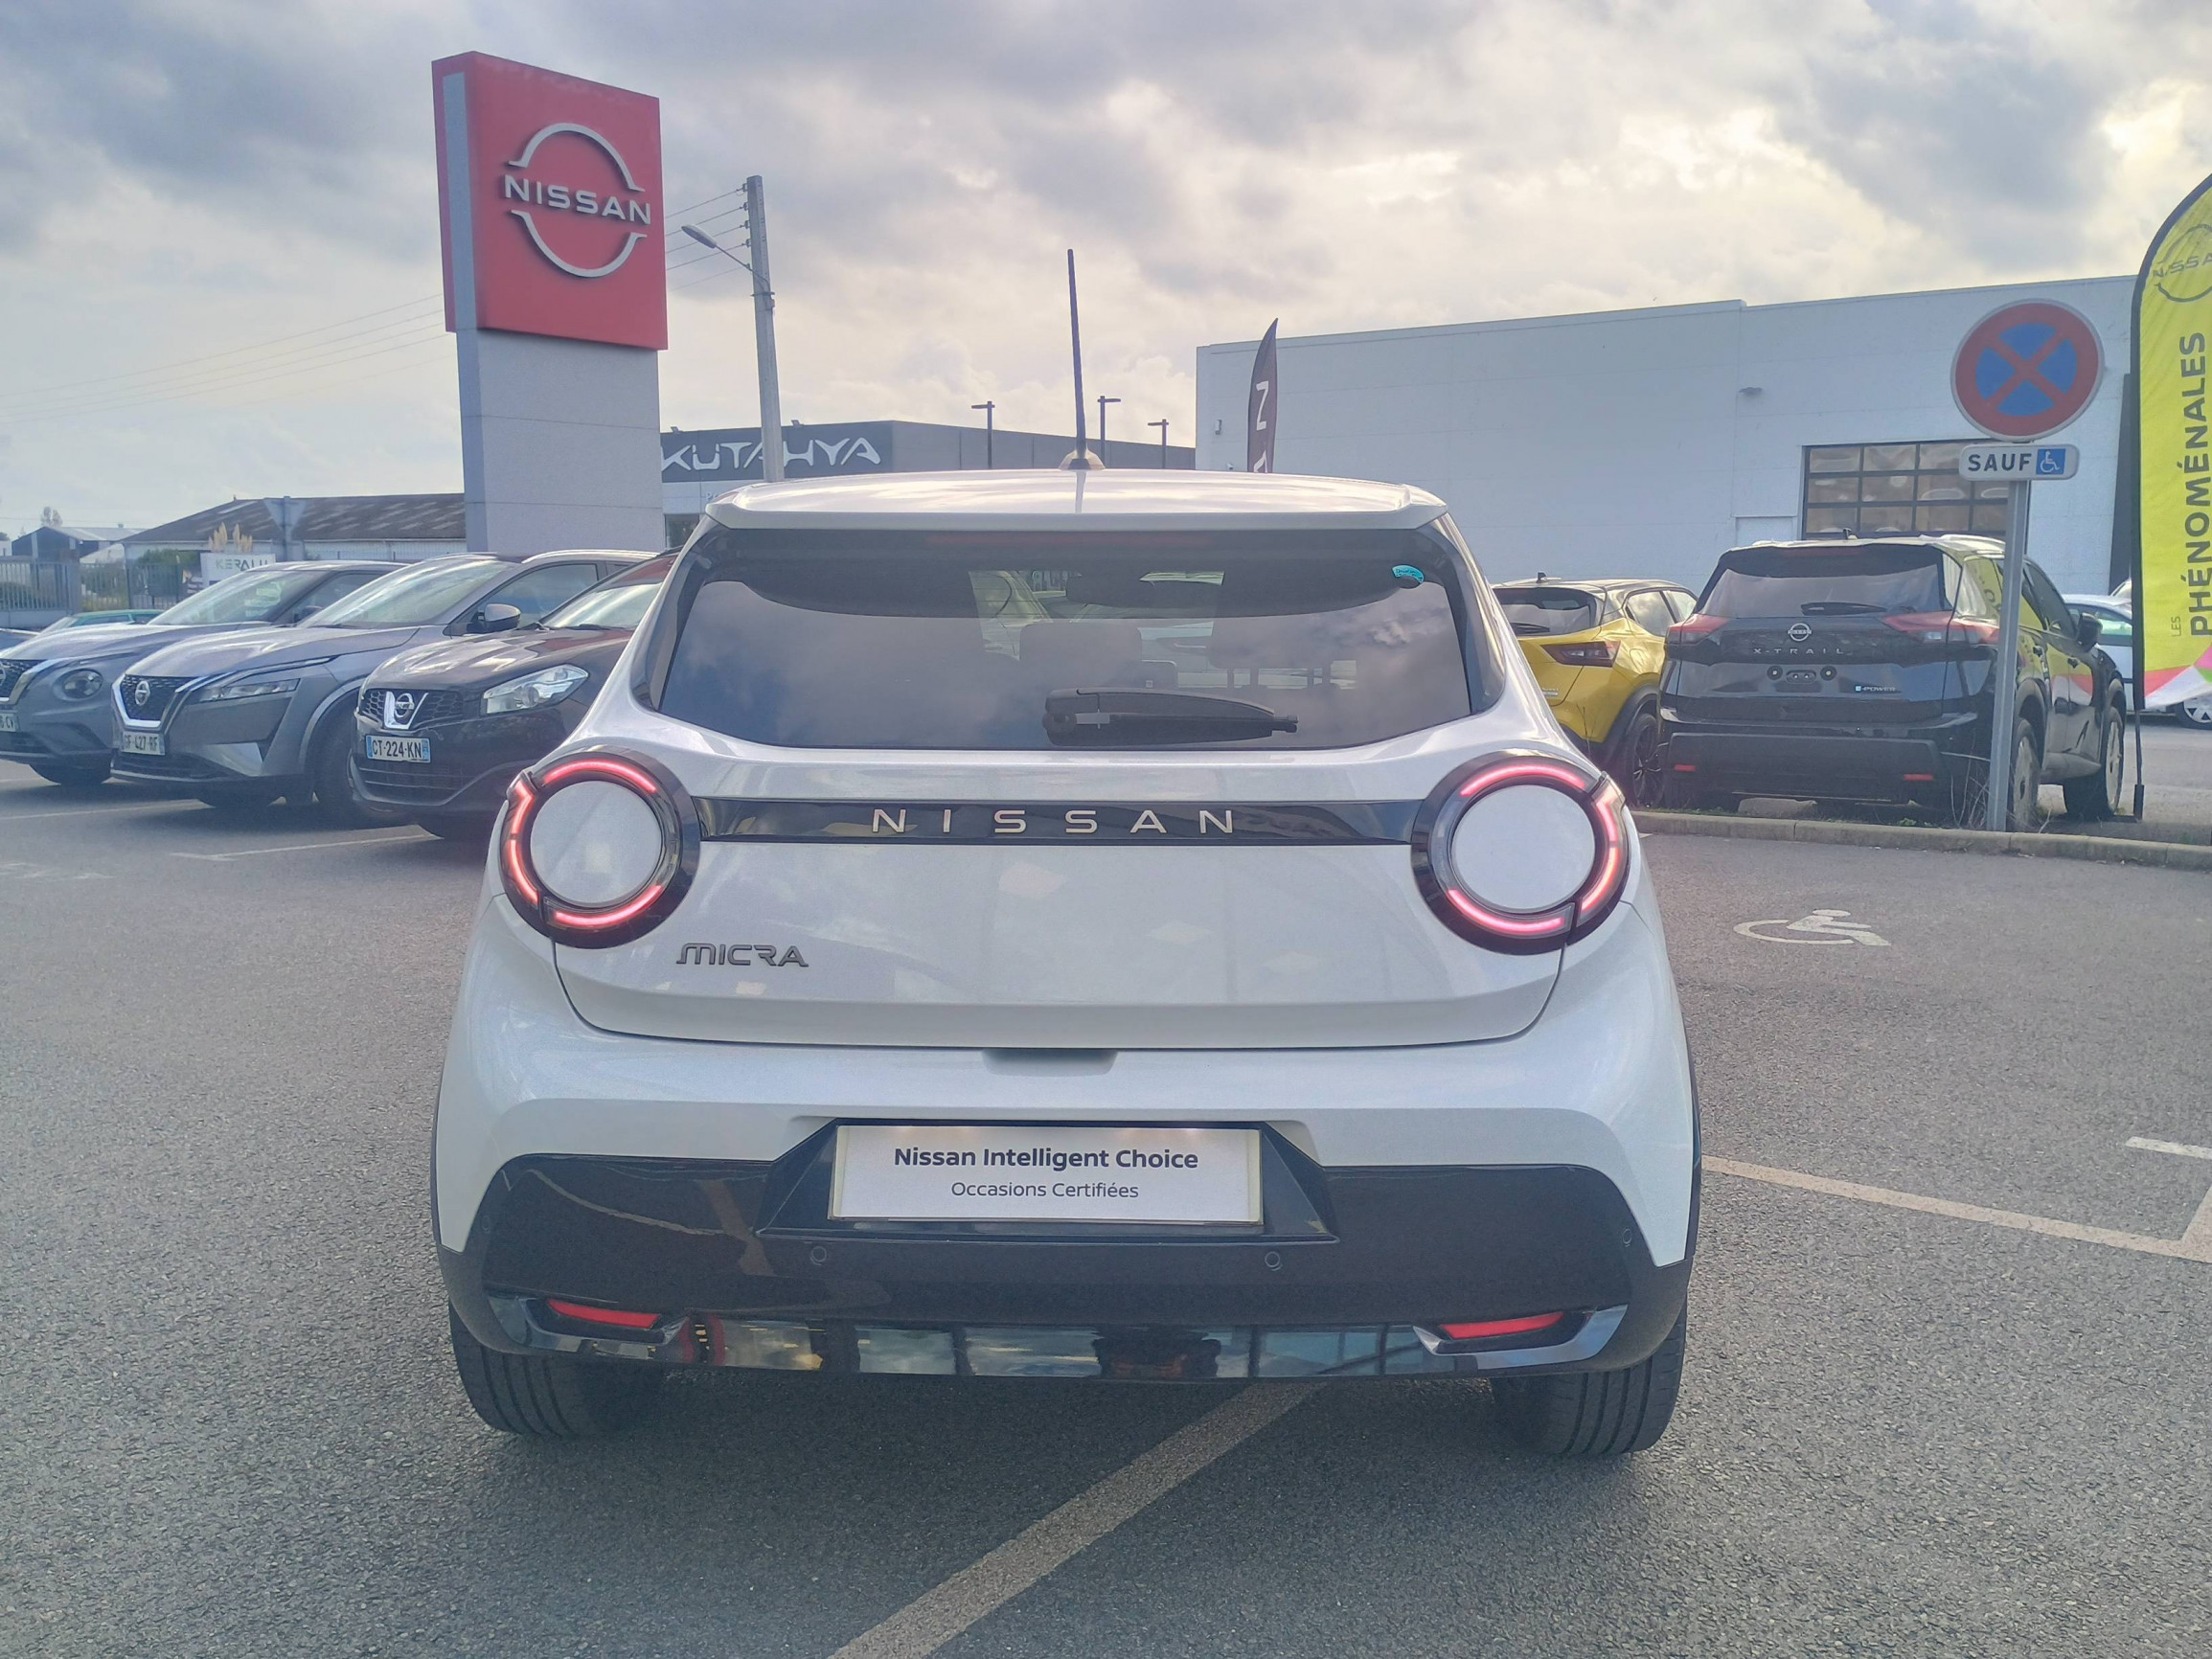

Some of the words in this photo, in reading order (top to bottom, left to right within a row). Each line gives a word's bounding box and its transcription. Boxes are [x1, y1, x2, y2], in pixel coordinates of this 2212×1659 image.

[504, 174, 651, 224] NISSAN
[2153, 252, 2212, 279] NISSA
[1968, 453, 2032, 471] SAUF
[2177, 331, 2212, 636] PHÉNOMÉNALES
[2171, 616, 2181, 637] LES
[871, 808, 1235, 833] NISSAN
[675, 943, 810, 967] MICRA
[895, 1148, 975, 1166] Nissan
[984, 1148, 1108, 1171] Intelligent
[1116, 1149, 1198, 1168] Choice
[951, 1182, 1046, 1196] Occasions
[1052, 1182, 1139, 1197] Certifiées
